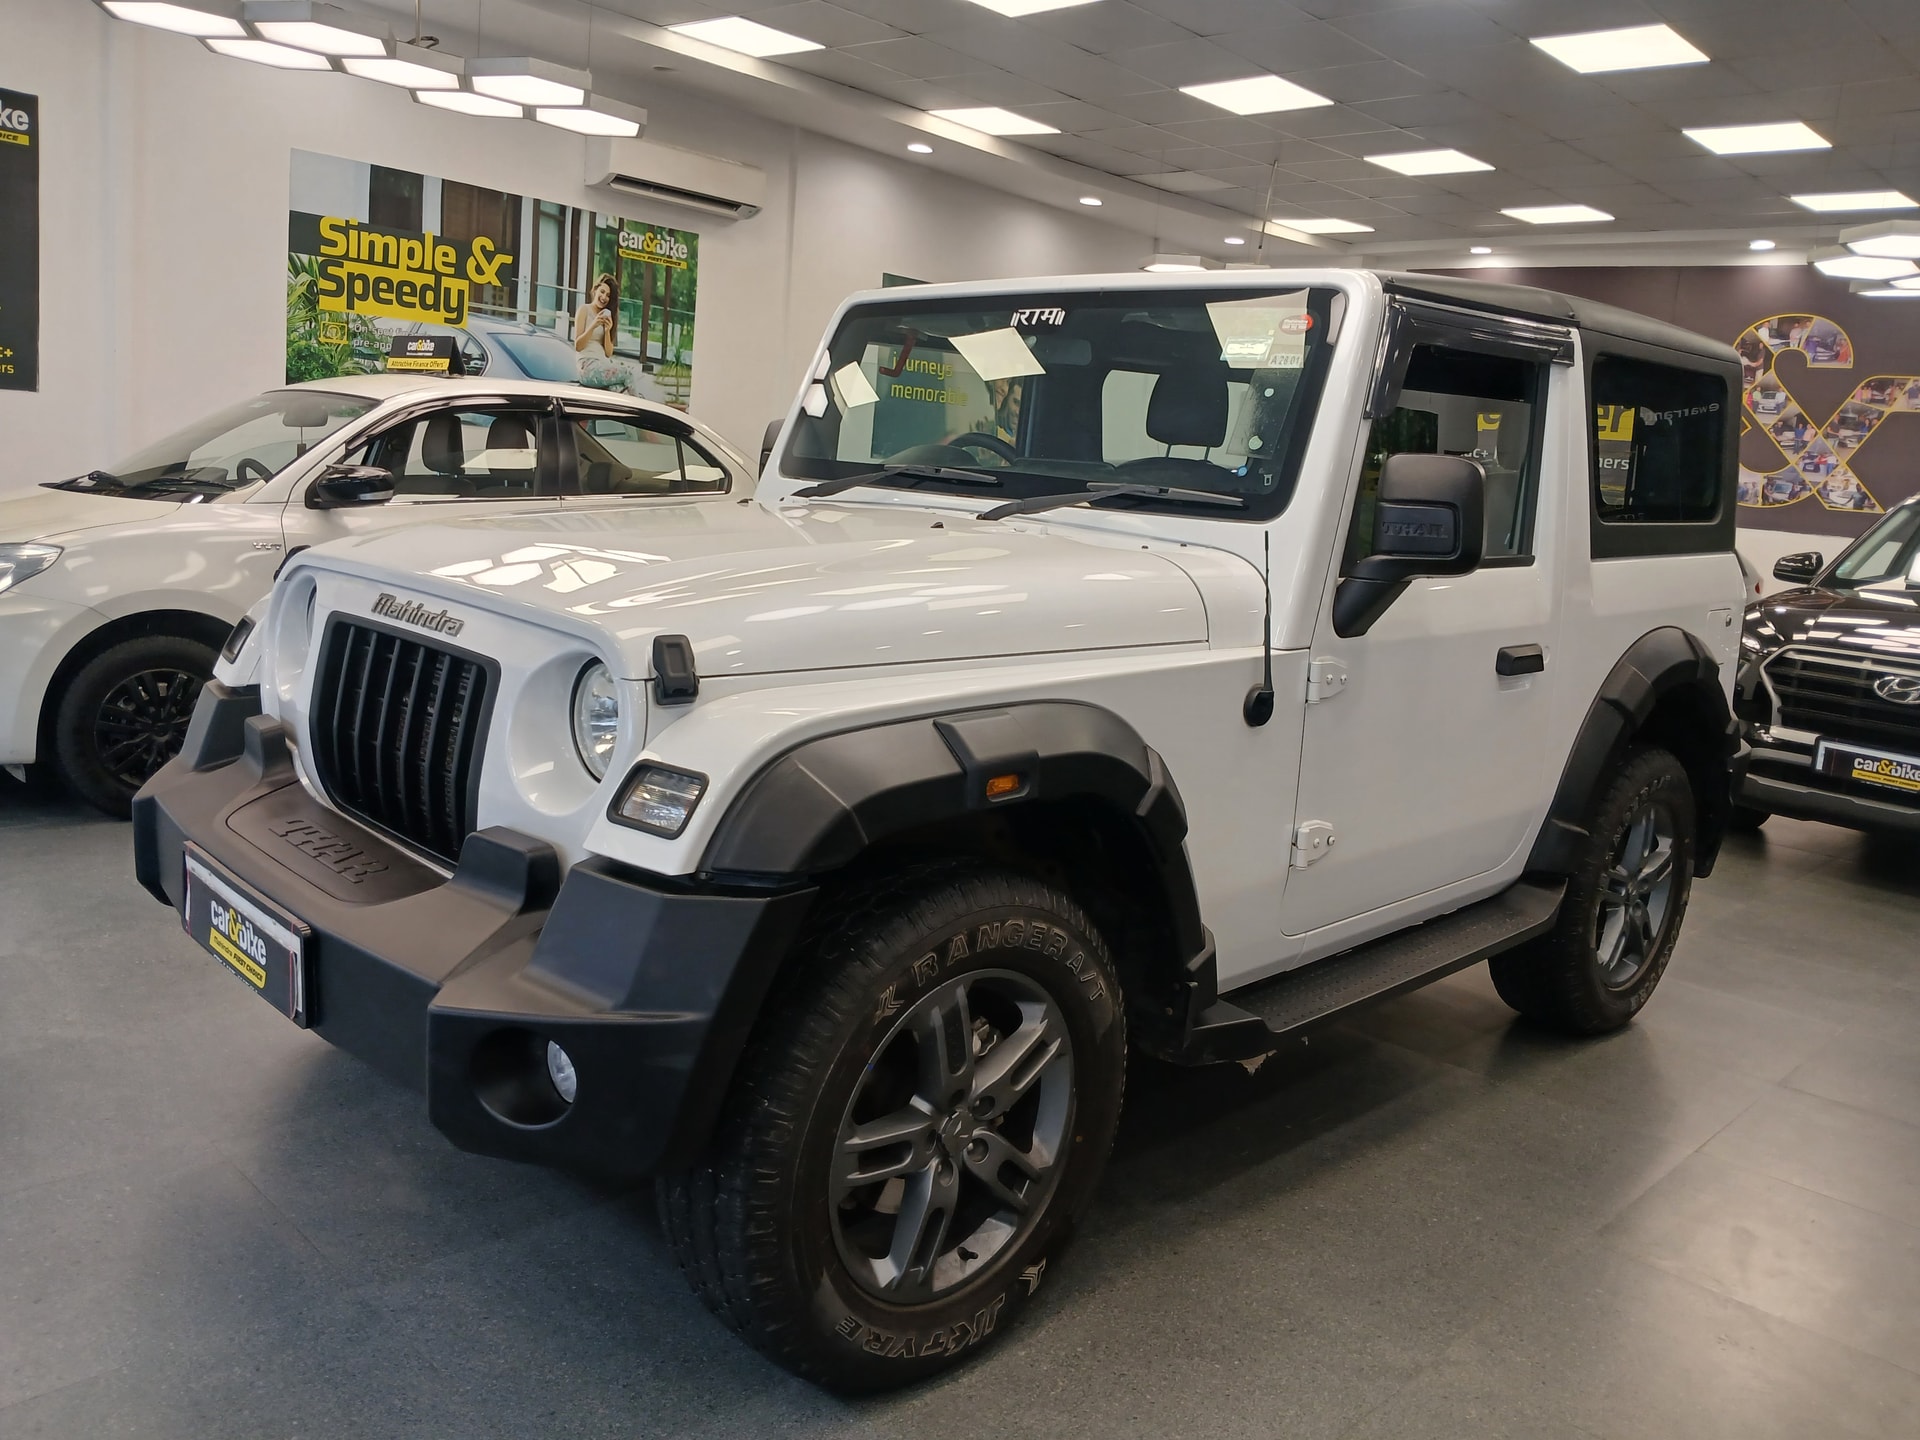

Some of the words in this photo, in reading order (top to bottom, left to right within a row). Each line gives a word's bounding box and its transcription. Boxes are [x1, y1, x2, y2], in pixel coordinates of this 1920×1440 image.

[319, 215, 457, 275] Simple
[466, 236, 514, 287] &
[618, 231, 688, 259] car&bike
[319, 258, 465, 325] Speedy
[391, 360, 412, 368] Attractive
[412, 360, 429, 368] Finance
[407, 339, 435, 352] car&bike
[892, 351, 953, 380] jurneys
[371, 592, 465, 638] Mahindra
[268, 819, 390, 884] THAR
[210, 900, 267, 966] car&bike
[912, 919, 1068, 987] RANGER
[233, 952, 246, 968] FIRST
[245, 963, 263, 982] CHOICE
